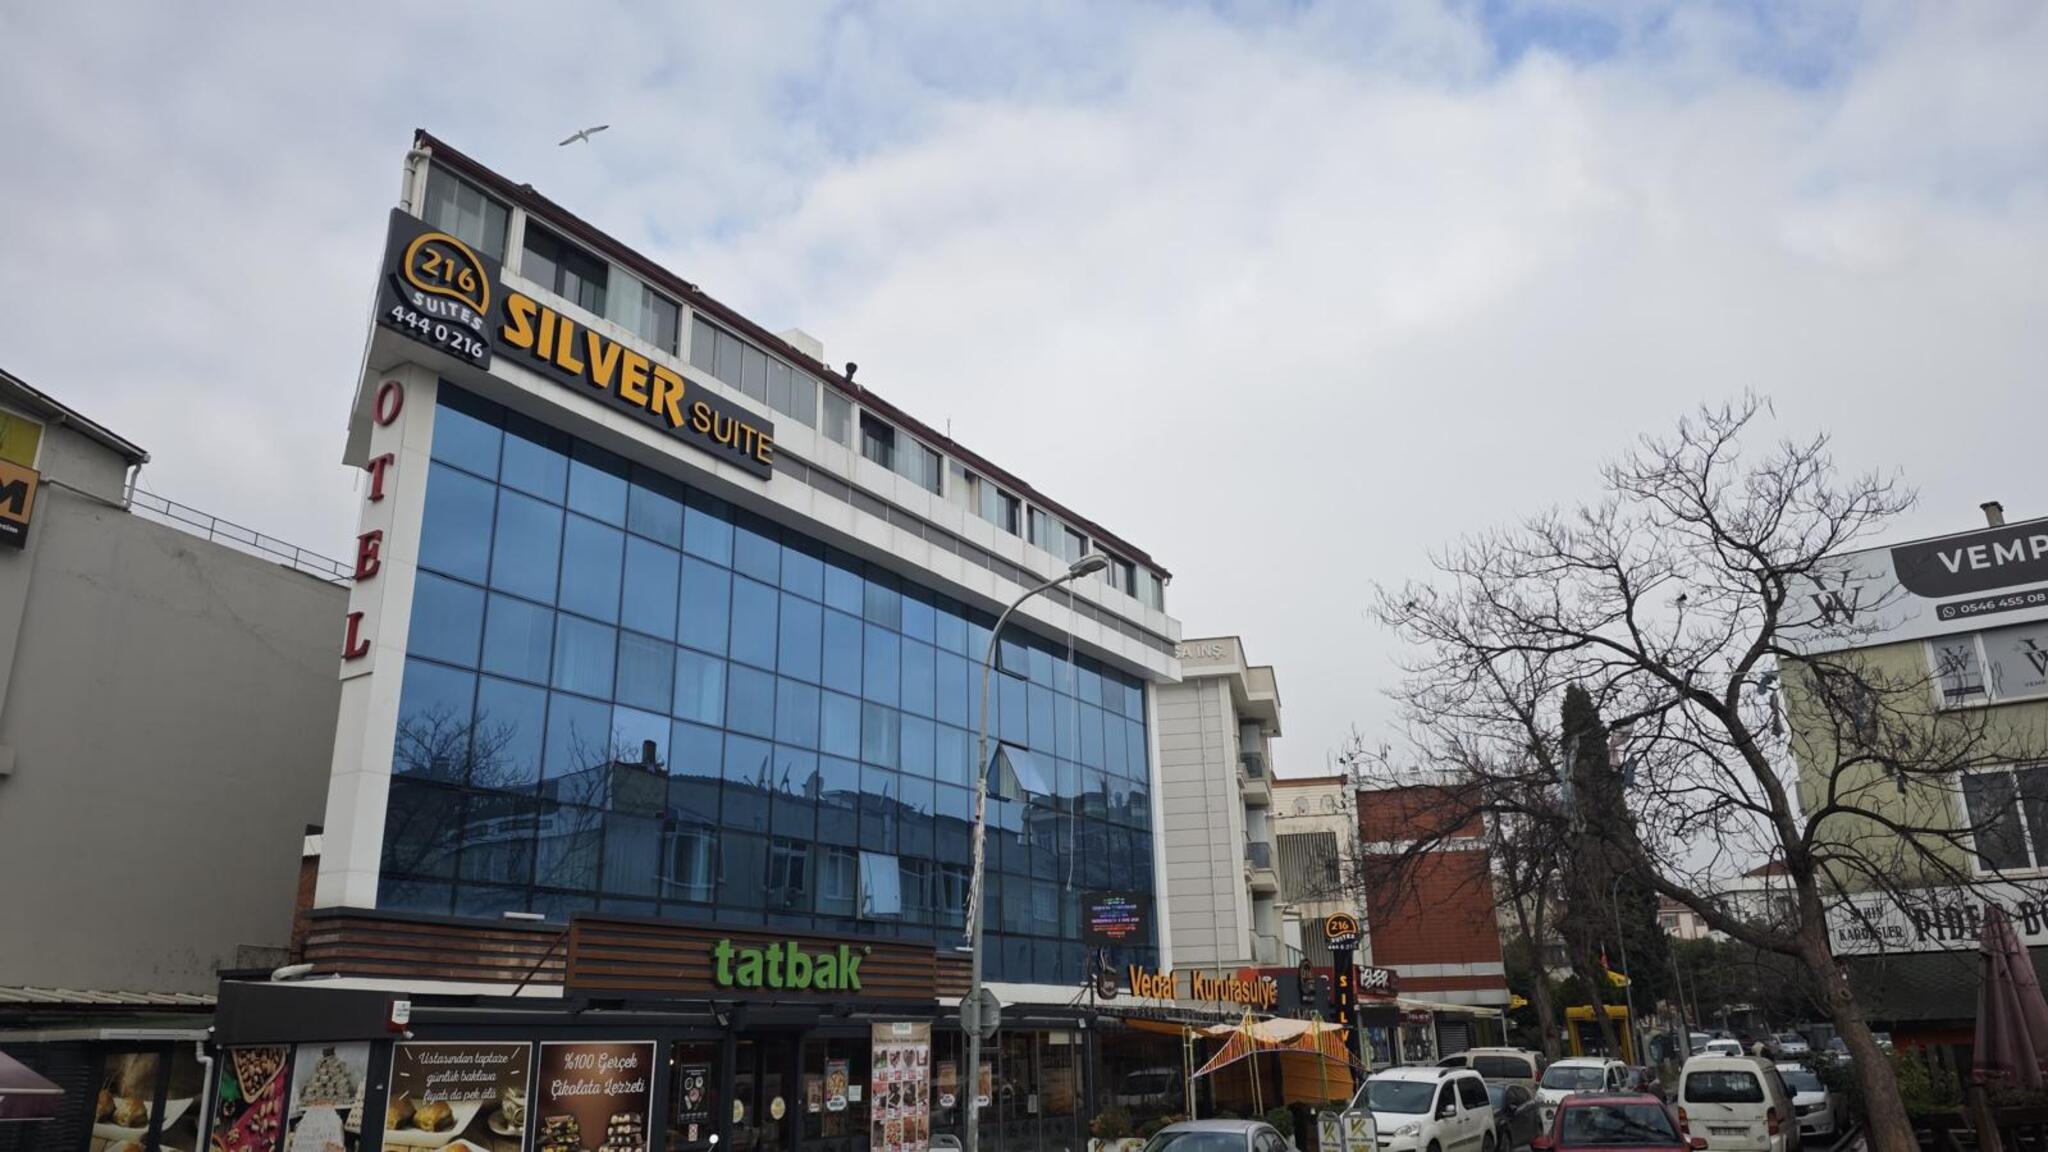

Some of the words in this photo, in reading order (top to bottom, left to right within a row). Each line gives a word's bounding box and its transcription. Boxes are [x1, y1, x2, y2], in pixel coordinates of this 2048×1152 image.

[422, 247, 476, 293] 216
[412, 291, 483, 331] SUITES
[503, 292, 686, 429] SILVER
[691, 400, 774, 465] SUITE
[1961, 600, 1996, 613] 0546
[1999, 596, 2025, 607] 455
[2027, 592, 2047, 603] 08
[1331, 920, 1350, 930] 216
[714, 938, 863, 991] tatbak
[1129, 963, 1177, 999] Vedat
[564, 1051, 595, 1070] %100
[597, 1051, 638, 1075] Gerçek
[551, 1079, 601, 1101] Çikolata
[603, 1077, 645, 1097] Lezzeti
